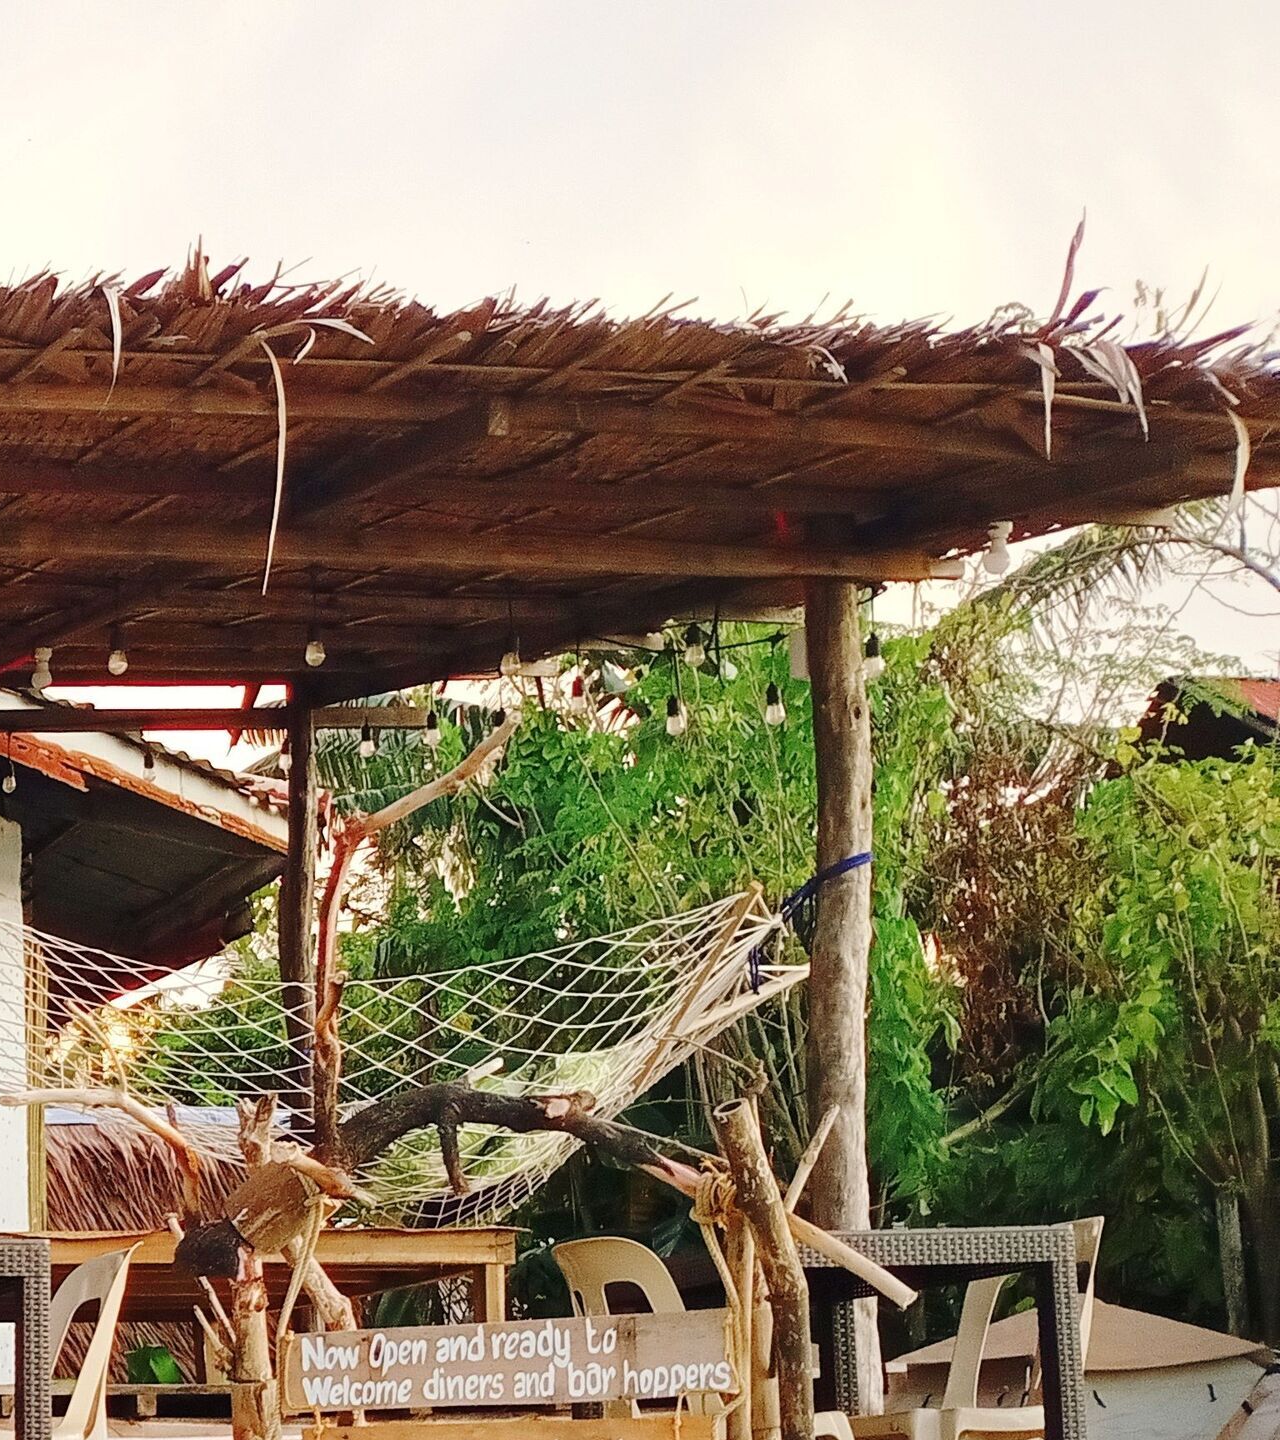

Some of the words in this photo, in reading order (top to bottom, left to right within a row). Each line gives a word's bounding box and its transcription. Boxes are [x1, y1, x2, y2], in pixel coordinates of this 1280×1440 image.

[301, 1336, 361, 1371] Now
[369, 1332, 428, 1376] Open
[435, 1325, 486, 1362] and
[492, 1320, 572, 1368] ready
[587, 1318, 617, 1355] to
[302, 1377, 412, 1408] Welcome
[423, 1369, 504, 1400] diners
[513, 1363, 556, 1398] and
[568, 1361, 617, 1397] bar
[624, 1360, 731, 1397] hoppers
